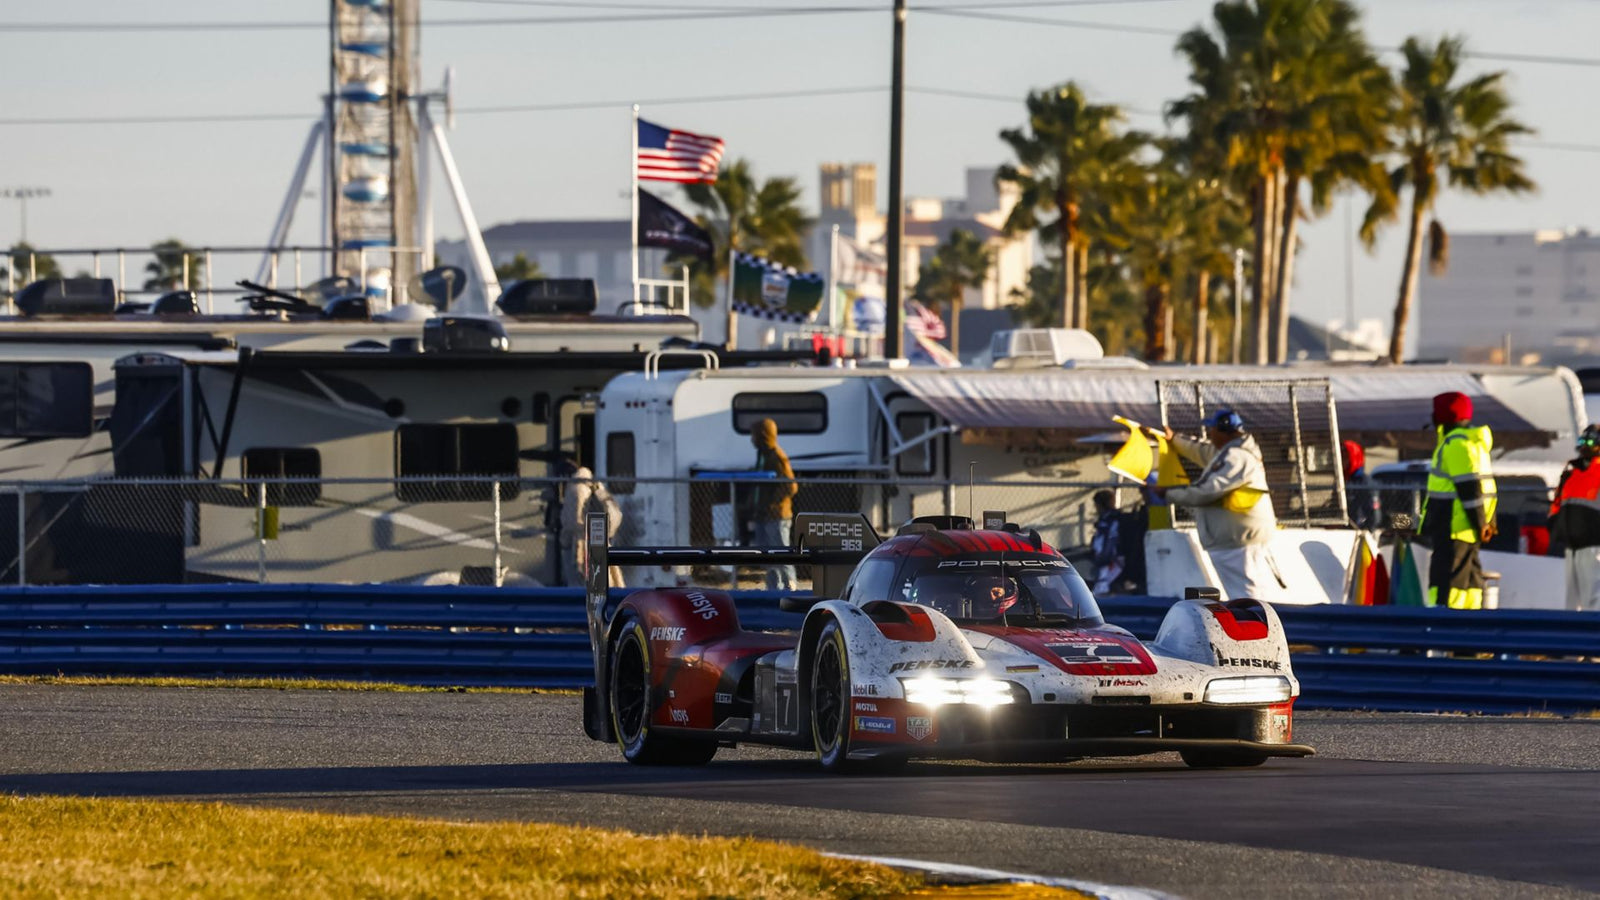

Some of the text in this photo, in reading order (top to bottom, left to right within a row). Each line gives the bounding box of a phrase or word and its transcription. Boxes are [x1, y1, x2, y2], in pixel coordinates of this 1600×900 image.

[808, 522, 863, 537] PORSCHE
[841, 539, 863, 551] 963
[937, 560, 1070, 569] PORSCHE
[650, 626, 687, 641] PENSKE
[1072, 645, 1099, 657] 7
[889, 660, 975, 674] PENSKE
[1218, 657, 1282, 671] PENSKE
[1112, 679, 1145, 687] IMSA
[853, 684, 867, 695] Mobil
[782, 688, 792, 726] 7
[855, 702, 878, 712] MOTUL
[909, 718, 930, 727] TAG
